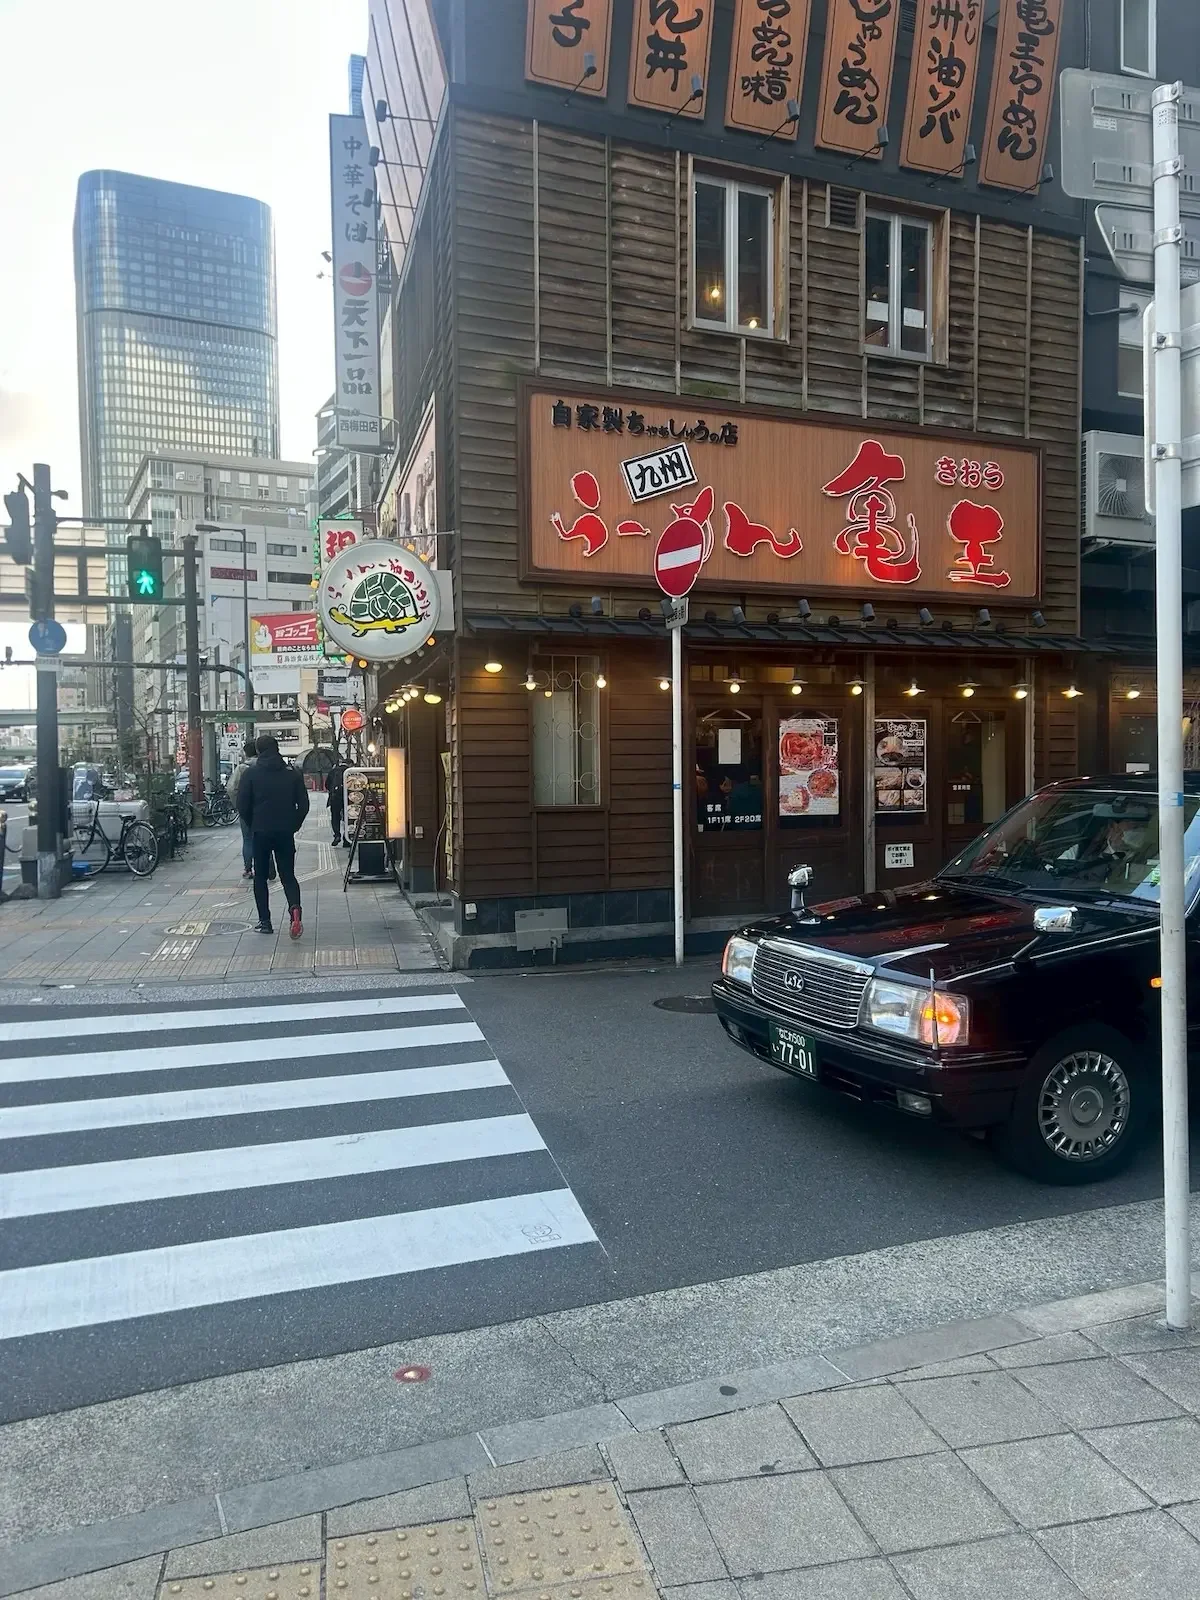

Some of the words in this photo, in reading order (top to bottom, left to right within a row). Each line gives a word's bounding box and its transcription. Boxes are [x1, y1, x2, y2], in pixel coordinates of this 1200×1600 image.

[341, 299, 373, 395] 天下一品
[340, 419, 378, 433] 西梅田店
[635, 452, 690, 493] 九州
[821, 438, 1013, 588] 亀王
[779, 1040, 813, 1073] 77-01
